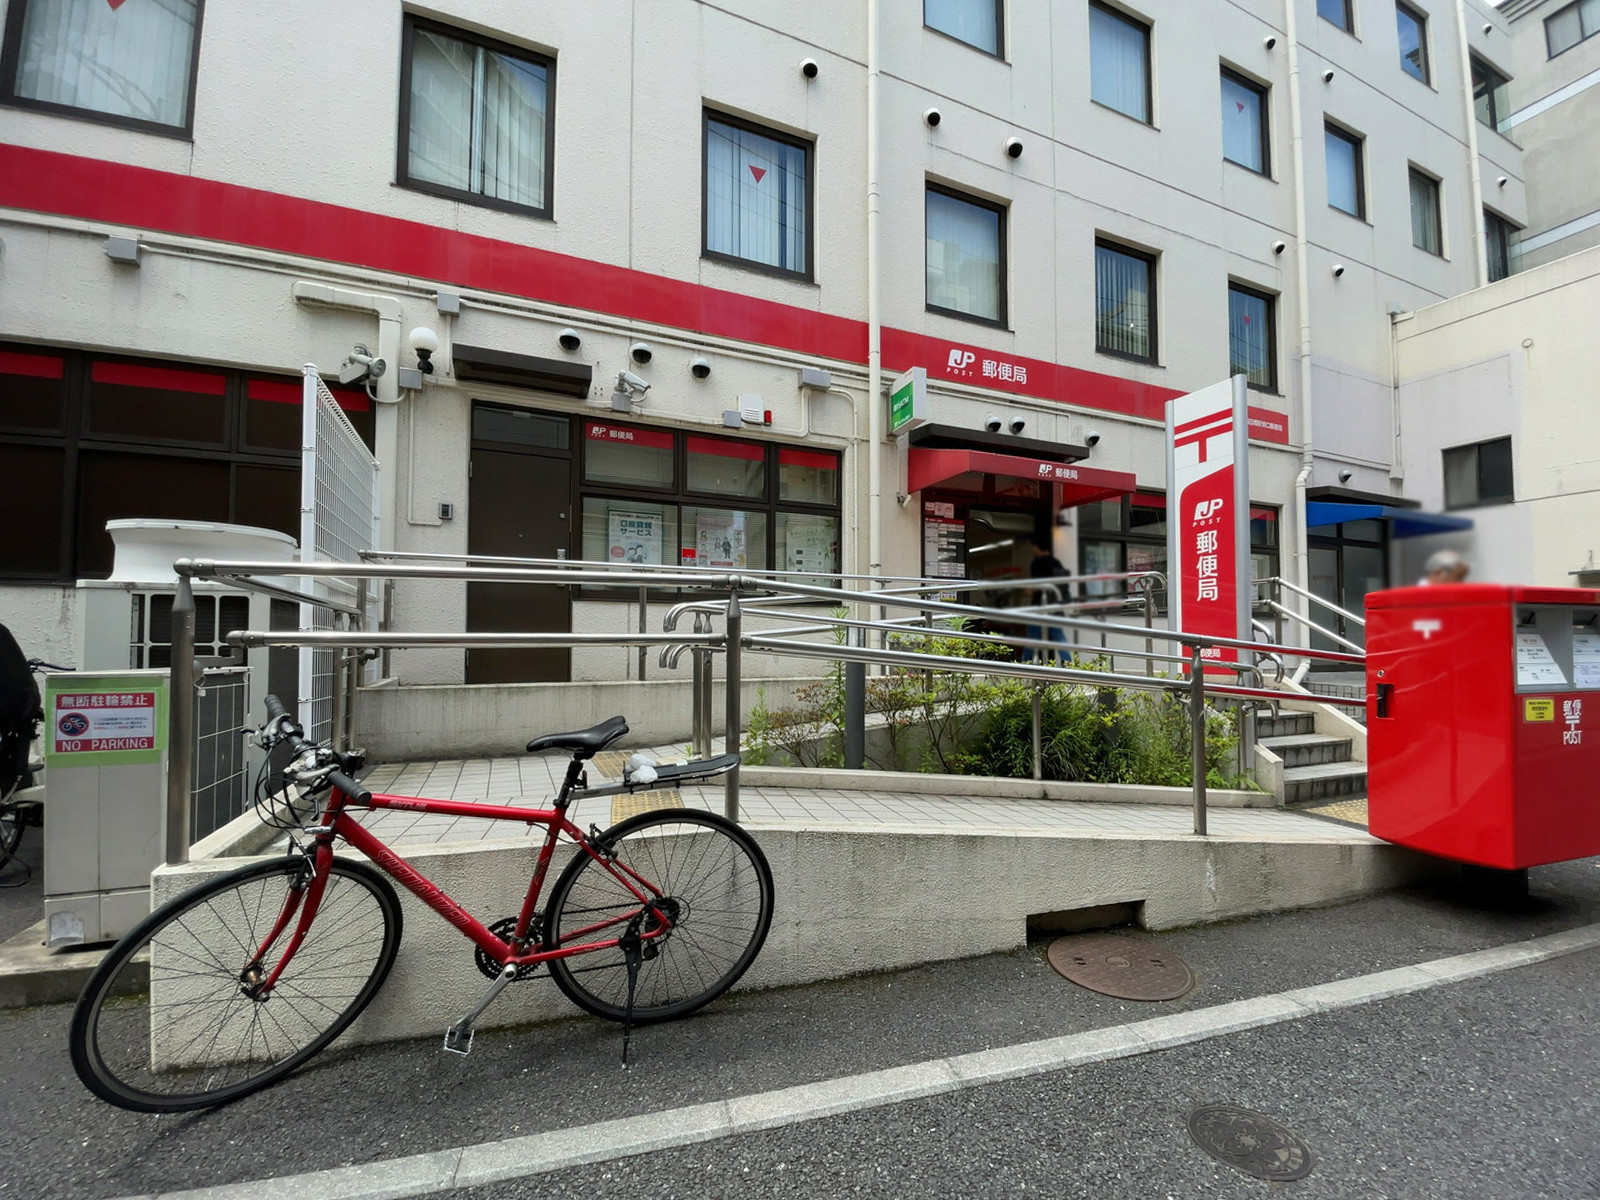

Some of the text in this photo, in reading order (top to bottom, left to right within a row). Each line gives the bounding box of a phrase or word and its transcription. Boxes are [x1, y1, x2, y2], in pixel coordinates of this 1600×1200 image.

[946, 366, 974, 378] POST
[982, 359, 1027, 385] 郵便局
[1192, 516, 1222, 528] POST
[620, 528, 652, 537] サービス
[1196, 530, 1219, 602] 郵便局
[61, 694, 149, 708] 無断駐輪禁止
[1563, 699, 1582, 716] 郵便
[62, 737, 148, 752] NO PARKING
[1563, 730, 1582, 745] POST
